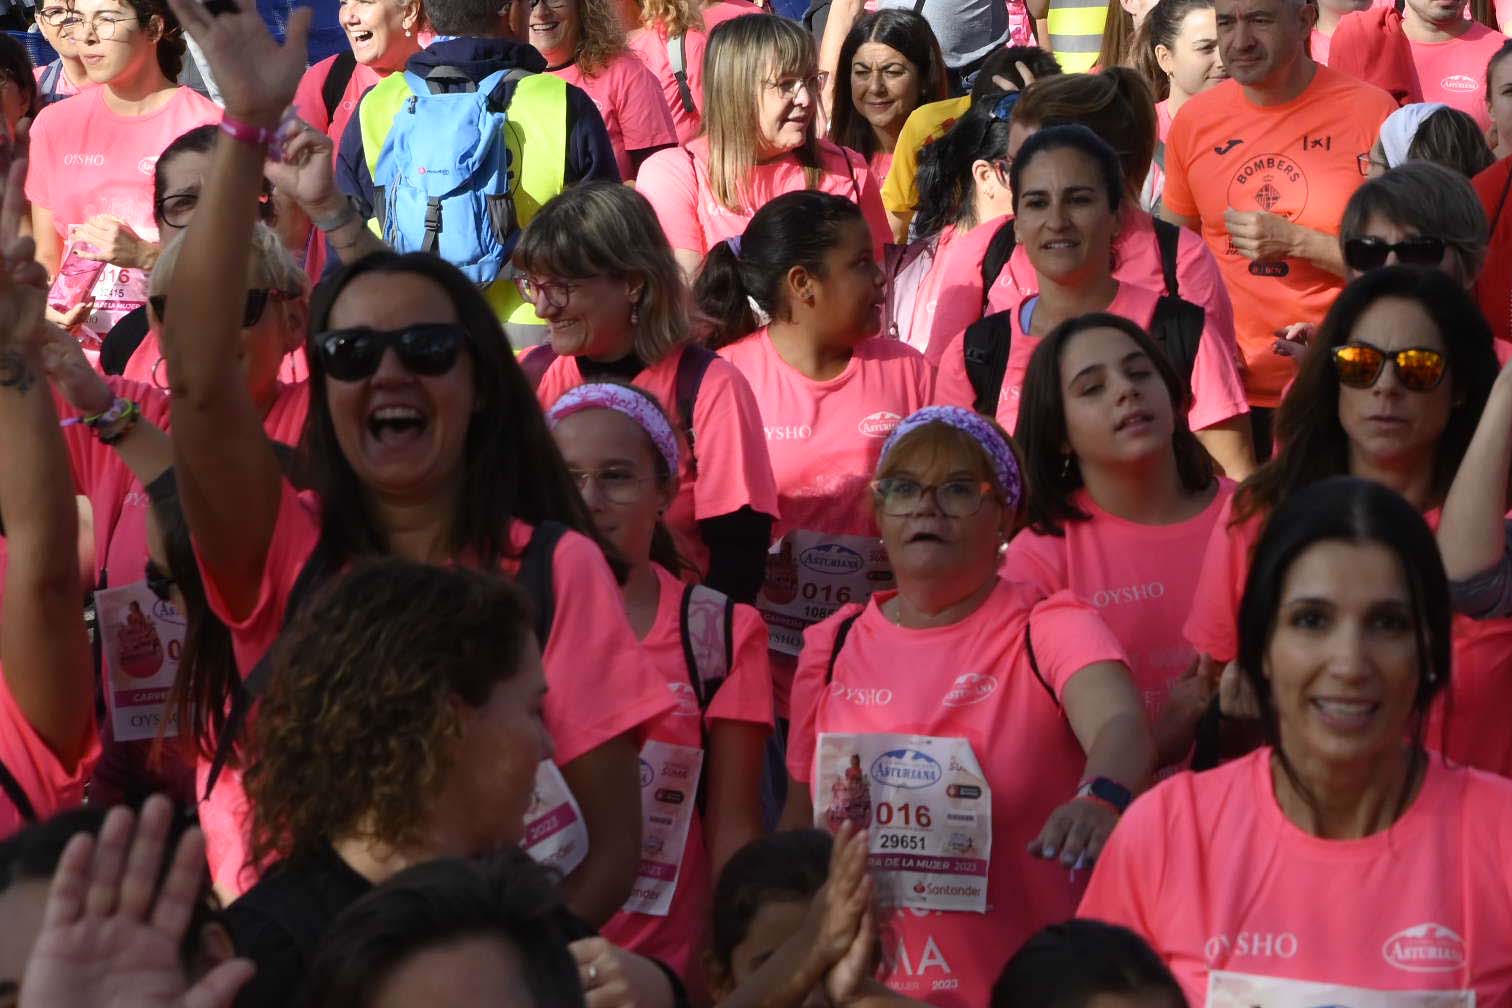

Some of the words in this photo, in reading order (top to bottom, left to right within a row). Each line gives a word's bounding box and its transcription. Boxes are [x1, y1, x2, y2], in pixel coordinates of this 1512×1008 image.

[1237, 158, 1300, 185] BOMBERS
[803, 582, 851, 602] 016
[1092, 581, 1165, 608] OYSHO
[875, 801, 933, 829] 016
[880, 833, 927, 851] 29651
[901, 858, 914, 868] LA
[916, 858, 950, 870] MUJER
